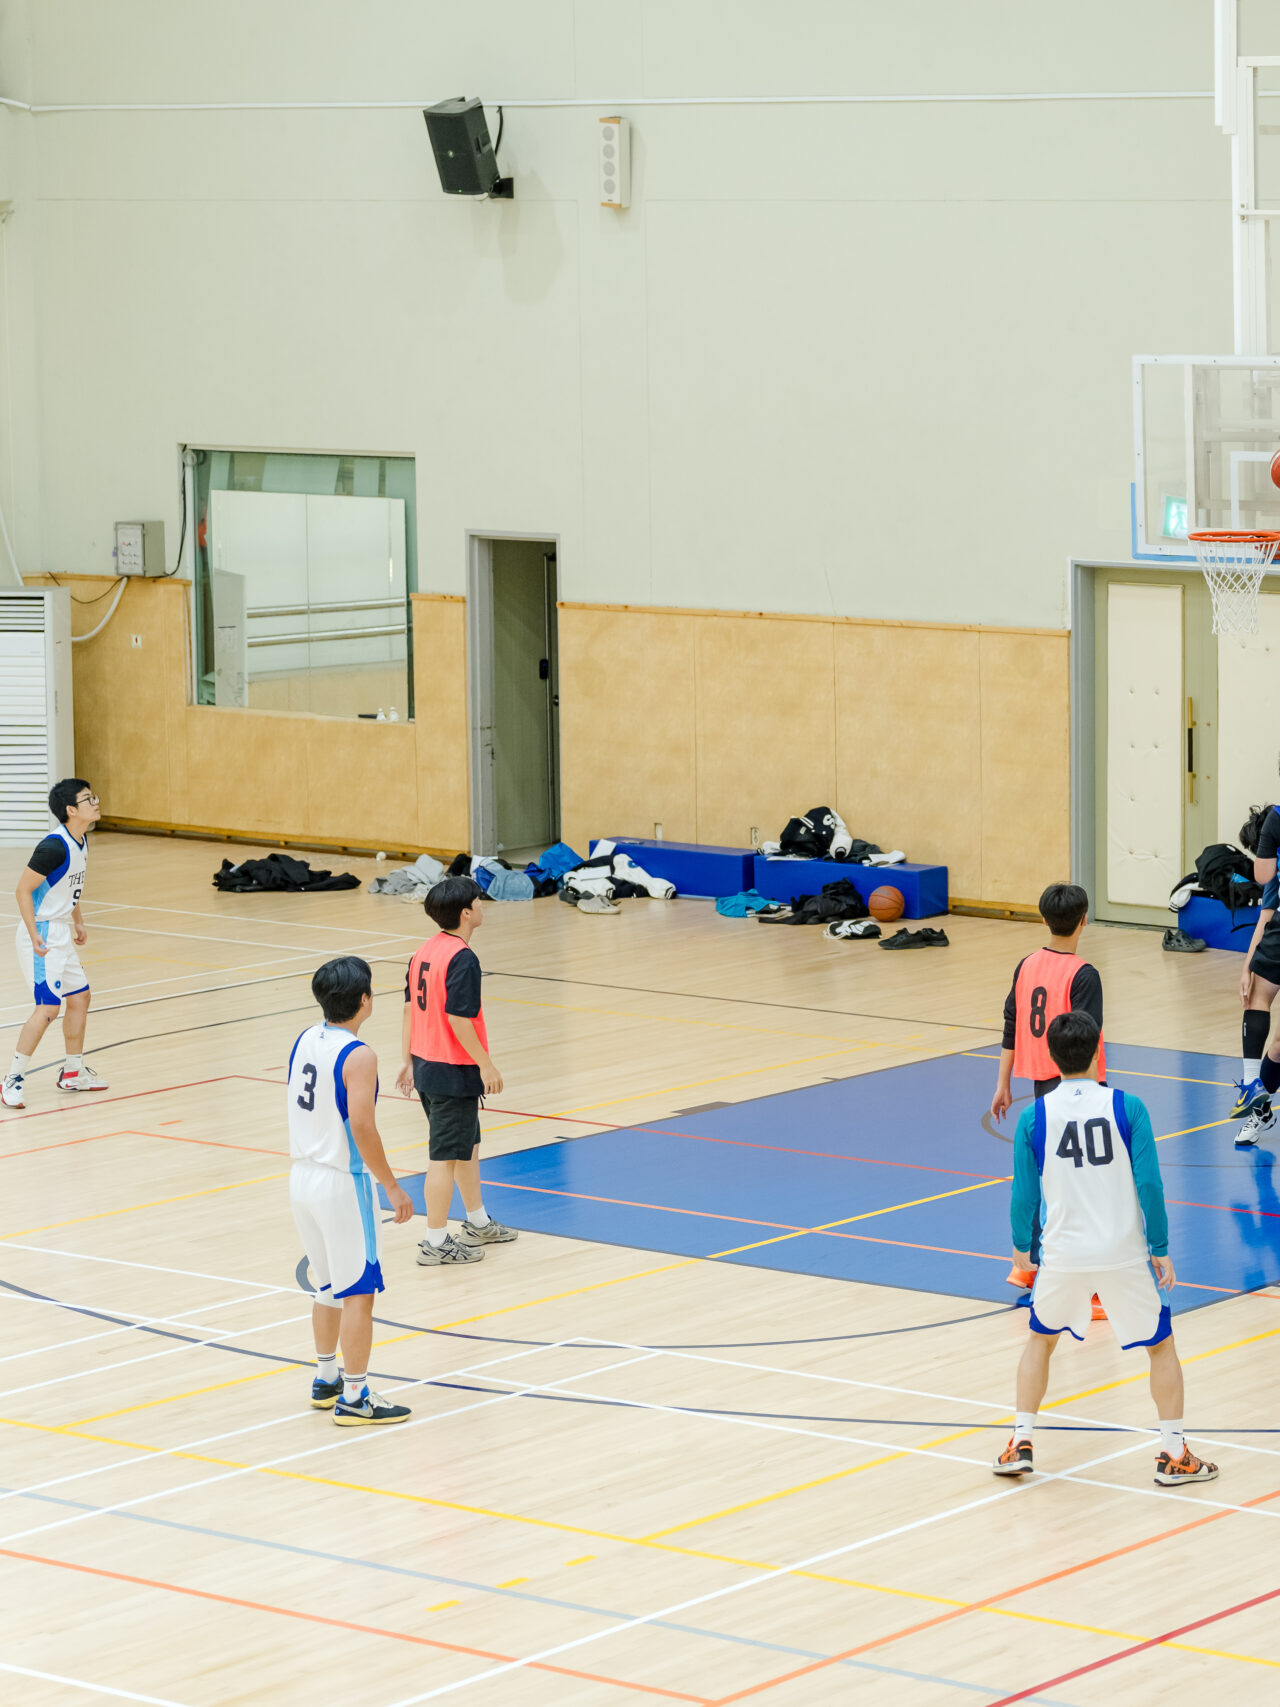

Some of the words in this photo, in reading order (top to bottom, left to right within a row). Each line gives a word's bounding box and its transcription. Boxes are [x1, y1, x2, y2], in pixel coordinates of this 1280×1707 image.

[417, 961, 431, 1012] 5
[1030, 986, 1047, 1038] 8
[297, 1062, 318, 1112] 3
[1056, 1117, 1114, 1168] 40
